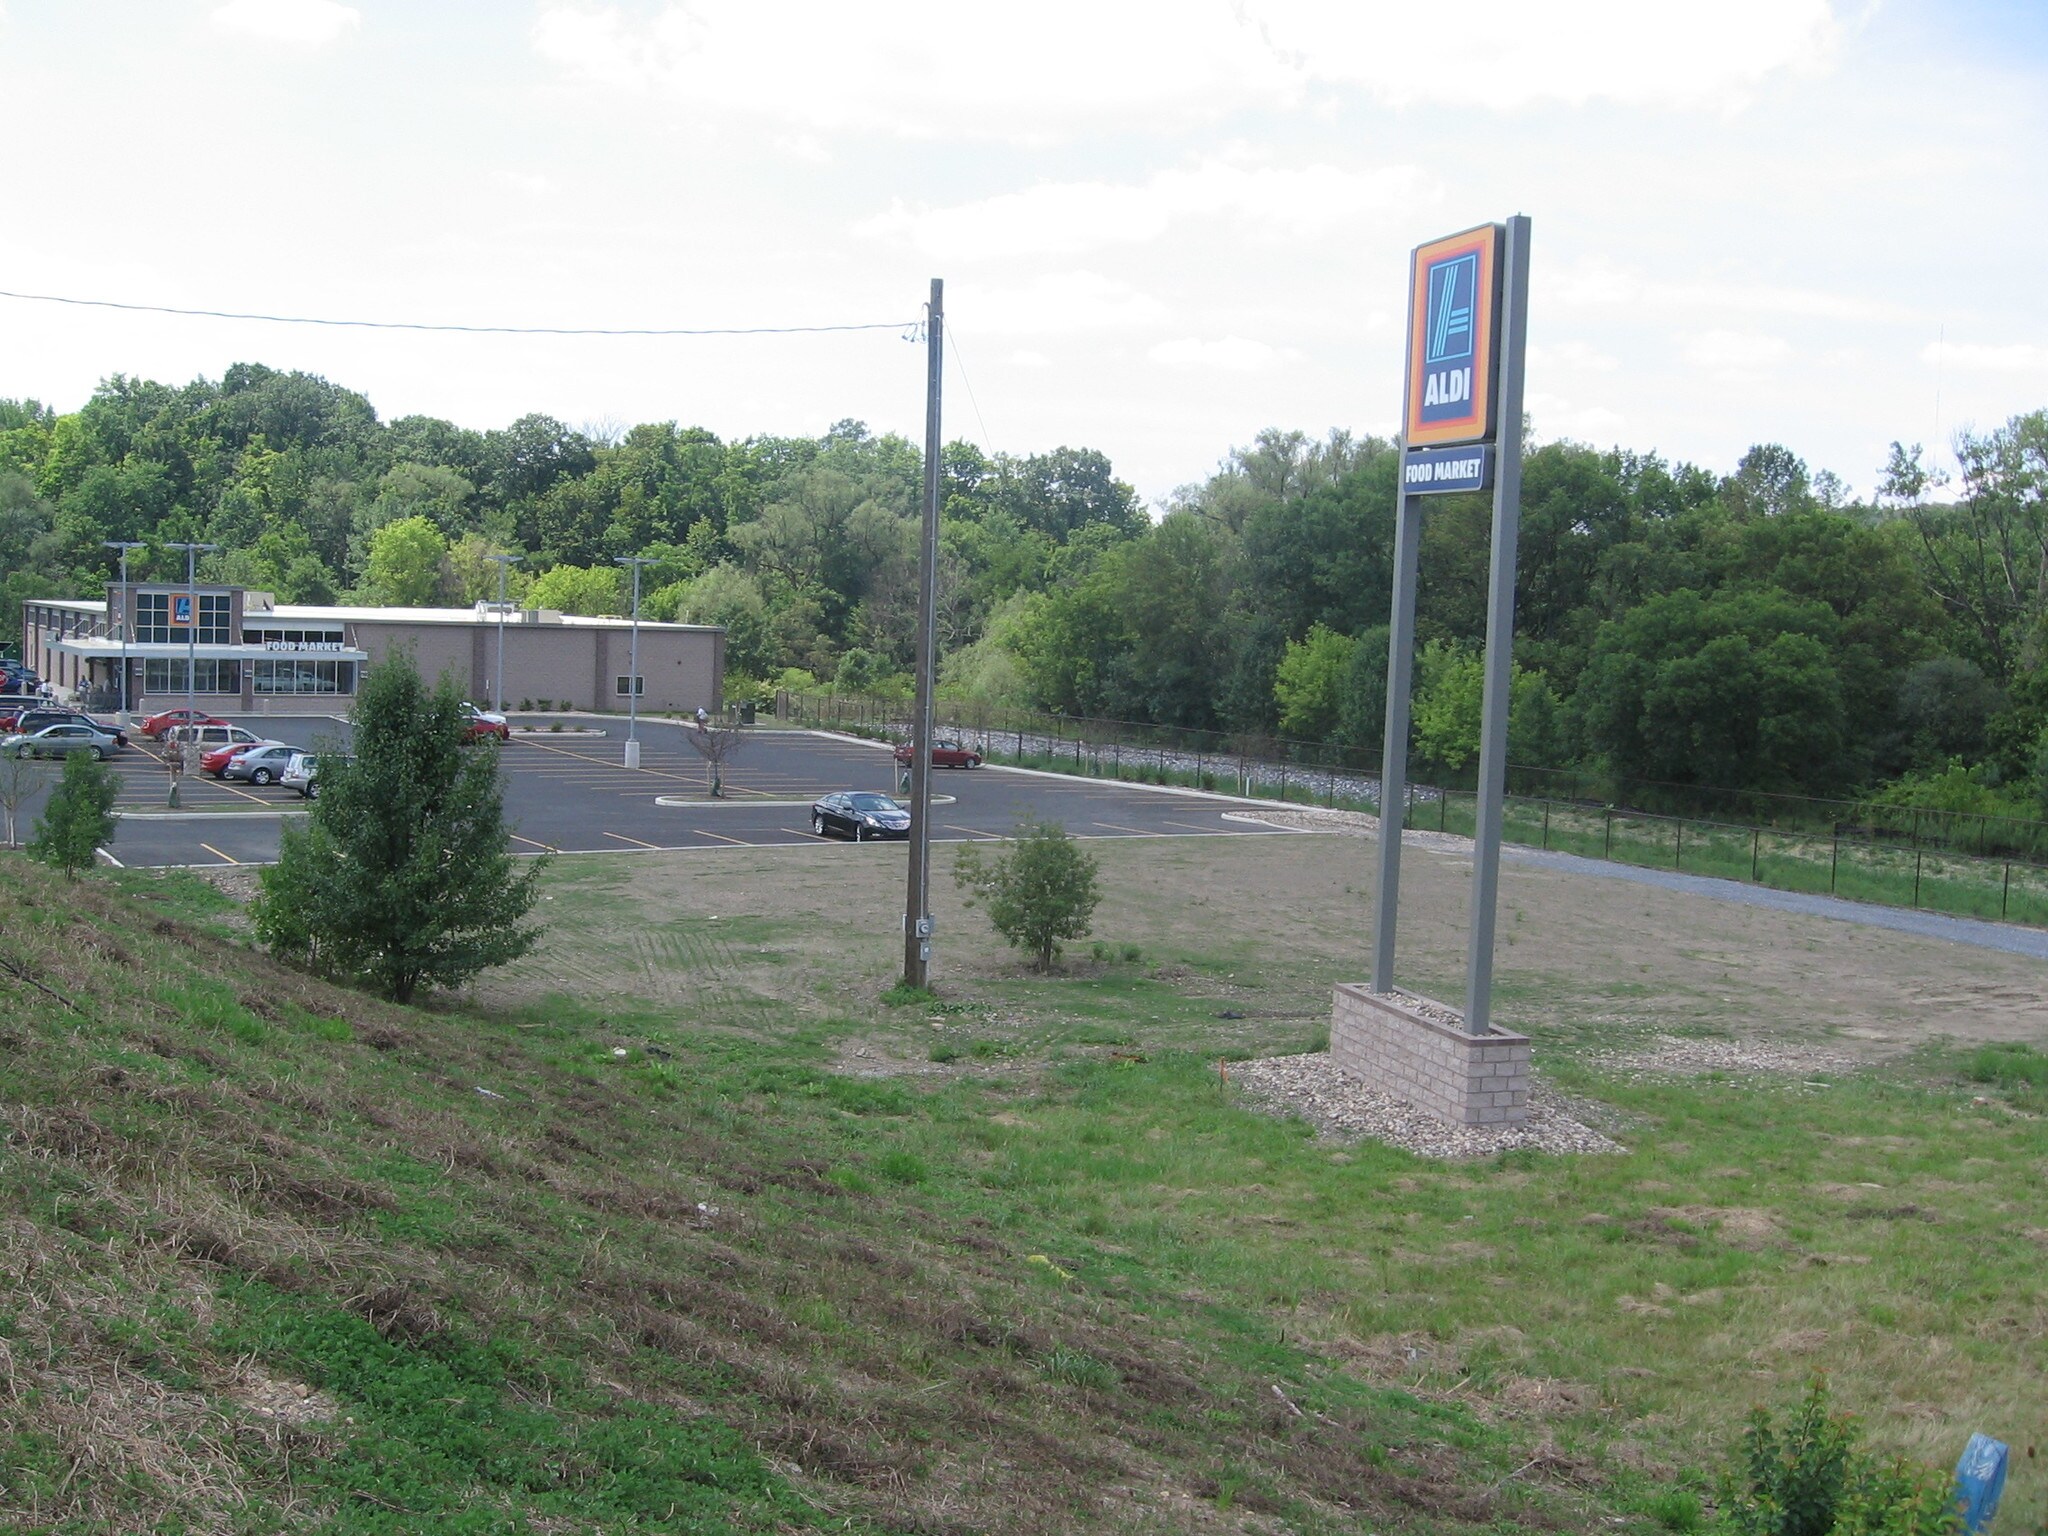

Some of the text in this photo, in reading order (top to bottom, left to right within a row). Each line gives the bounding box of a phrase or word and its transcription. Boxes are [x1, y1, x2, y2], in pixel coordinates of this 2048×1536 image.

[1424, 367, 1471, 407] ALDI
[1405, 458, 1481, 483] FOOD MARKET
[266, 641, 344, 652] FOOD MARKET
